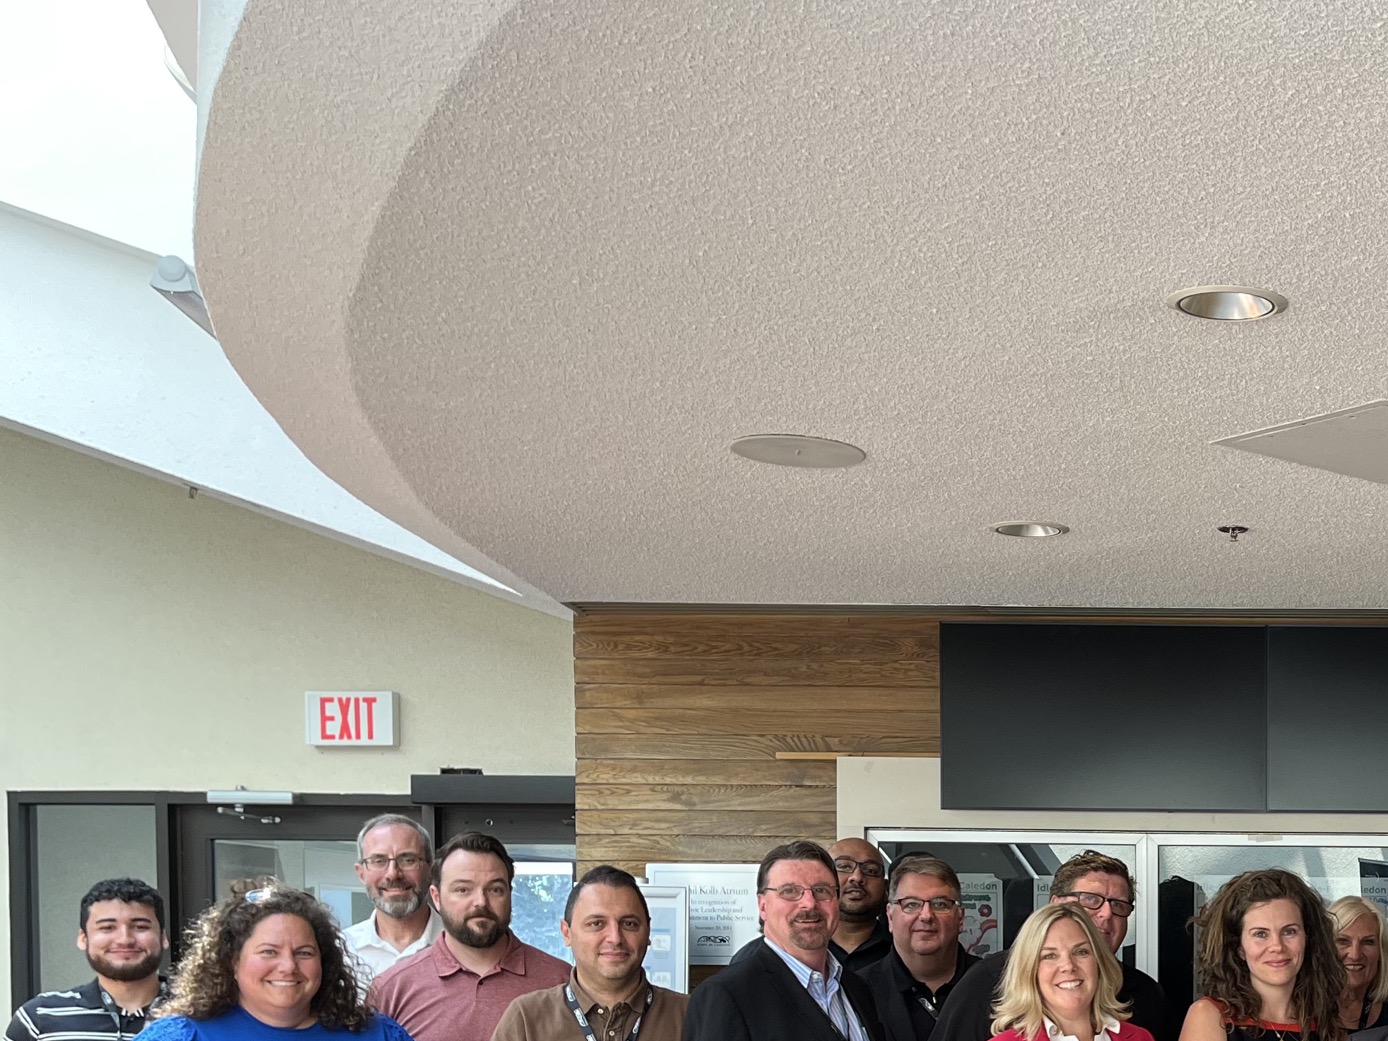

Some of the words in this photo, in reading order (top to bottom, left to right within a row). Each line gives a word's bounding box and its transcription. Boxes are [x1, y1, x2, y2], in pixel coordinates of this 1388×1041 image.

[320, 697, 377, 740] EXIT
[699, 885, 719, 895] Kolb
[720, 886, 749, 895] Atrium
[961, 881, 998, 891] Caledon
[701, 906, 732, 914] Leadership
